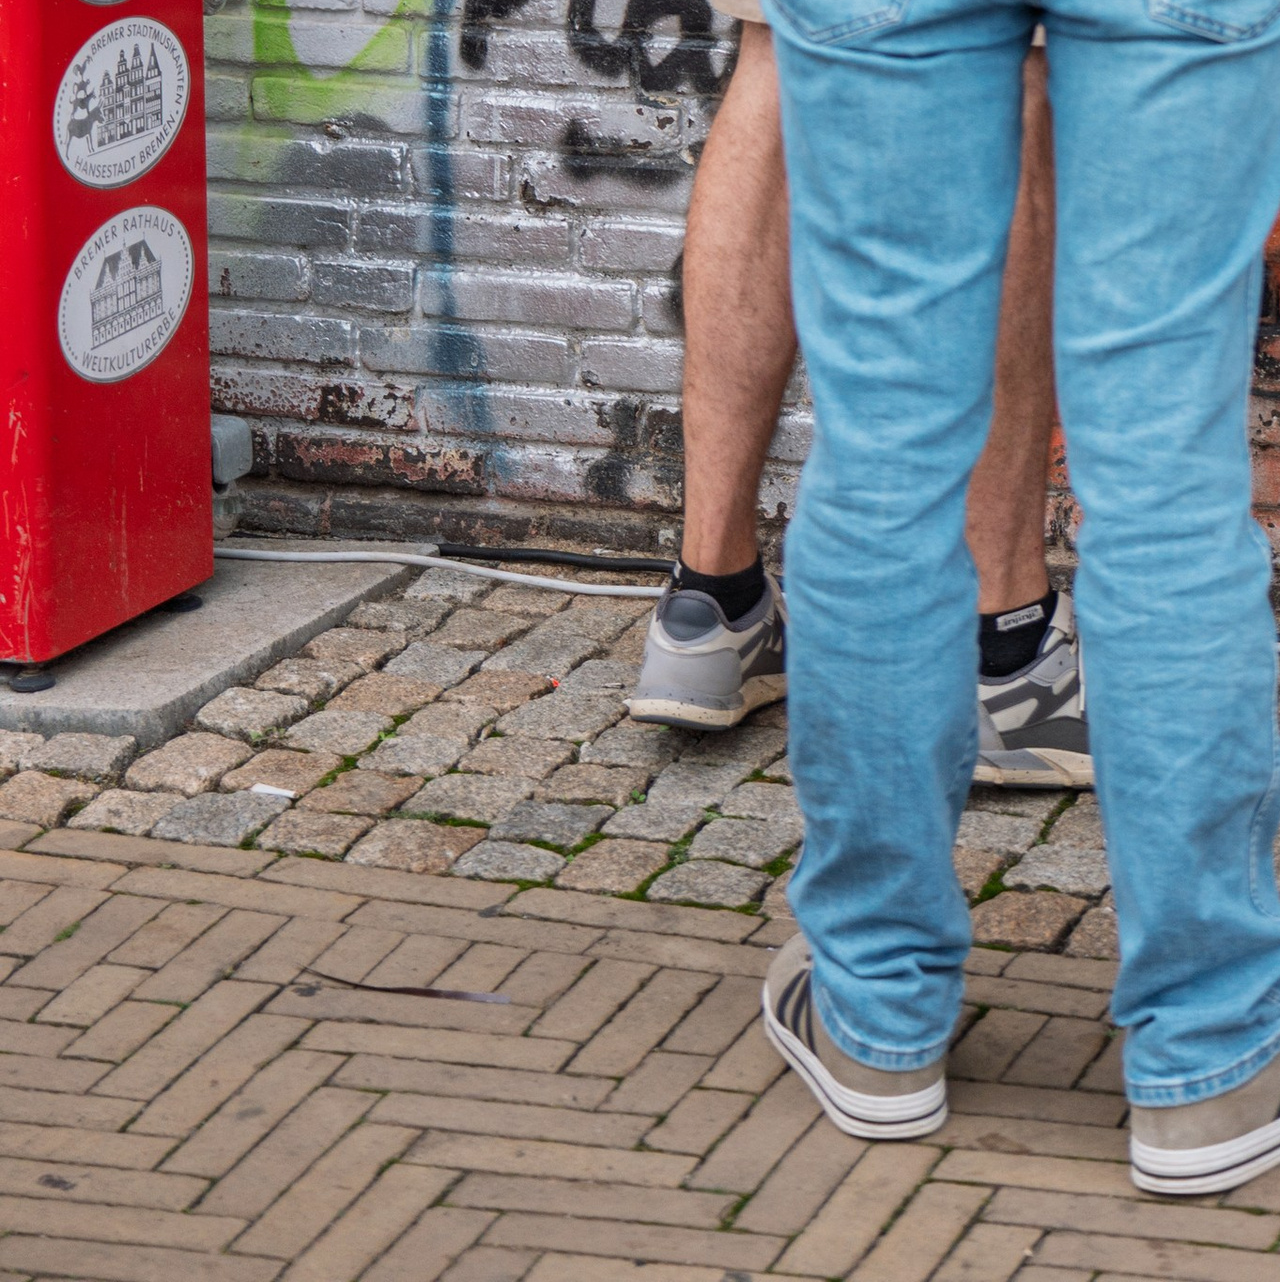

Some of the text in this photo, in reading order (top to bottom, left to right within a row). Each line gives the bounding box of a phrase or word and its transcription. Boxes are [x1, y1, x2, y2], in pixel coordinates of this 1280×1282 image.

[74, 216, 175, 281] BREMER RATHAUS
[82, 308, 176, 373] WELTKULTURERBE
